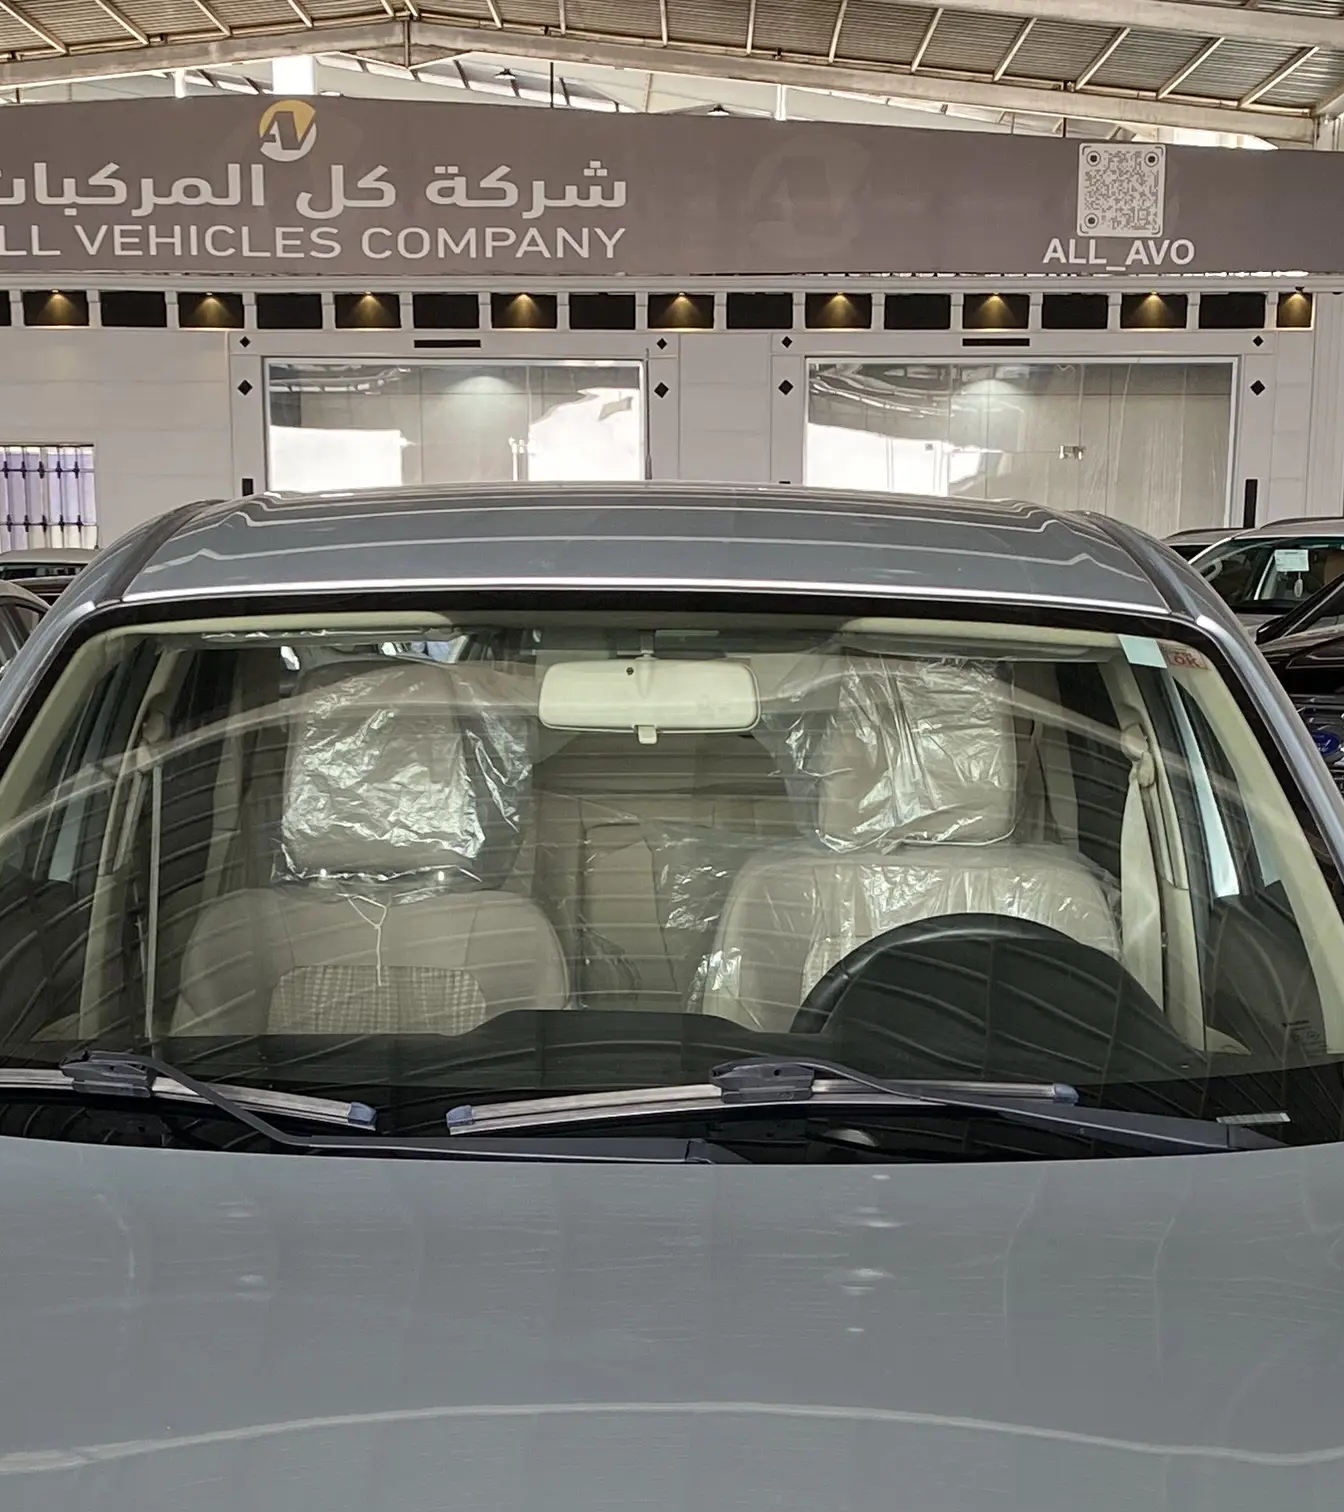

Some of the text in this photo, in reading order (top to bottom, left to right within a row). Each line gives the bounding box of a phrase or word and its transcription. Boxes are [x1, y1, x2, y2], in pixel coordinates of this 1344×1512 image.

[296, 164, 397, 219] كل
[425, 160, 627, 219] شركة
[74, 225, 341, 259] VEHICLES
[361, 227, 627, 259] COMPANY
[1042, 238, 1195, 271] ALL_AVO
